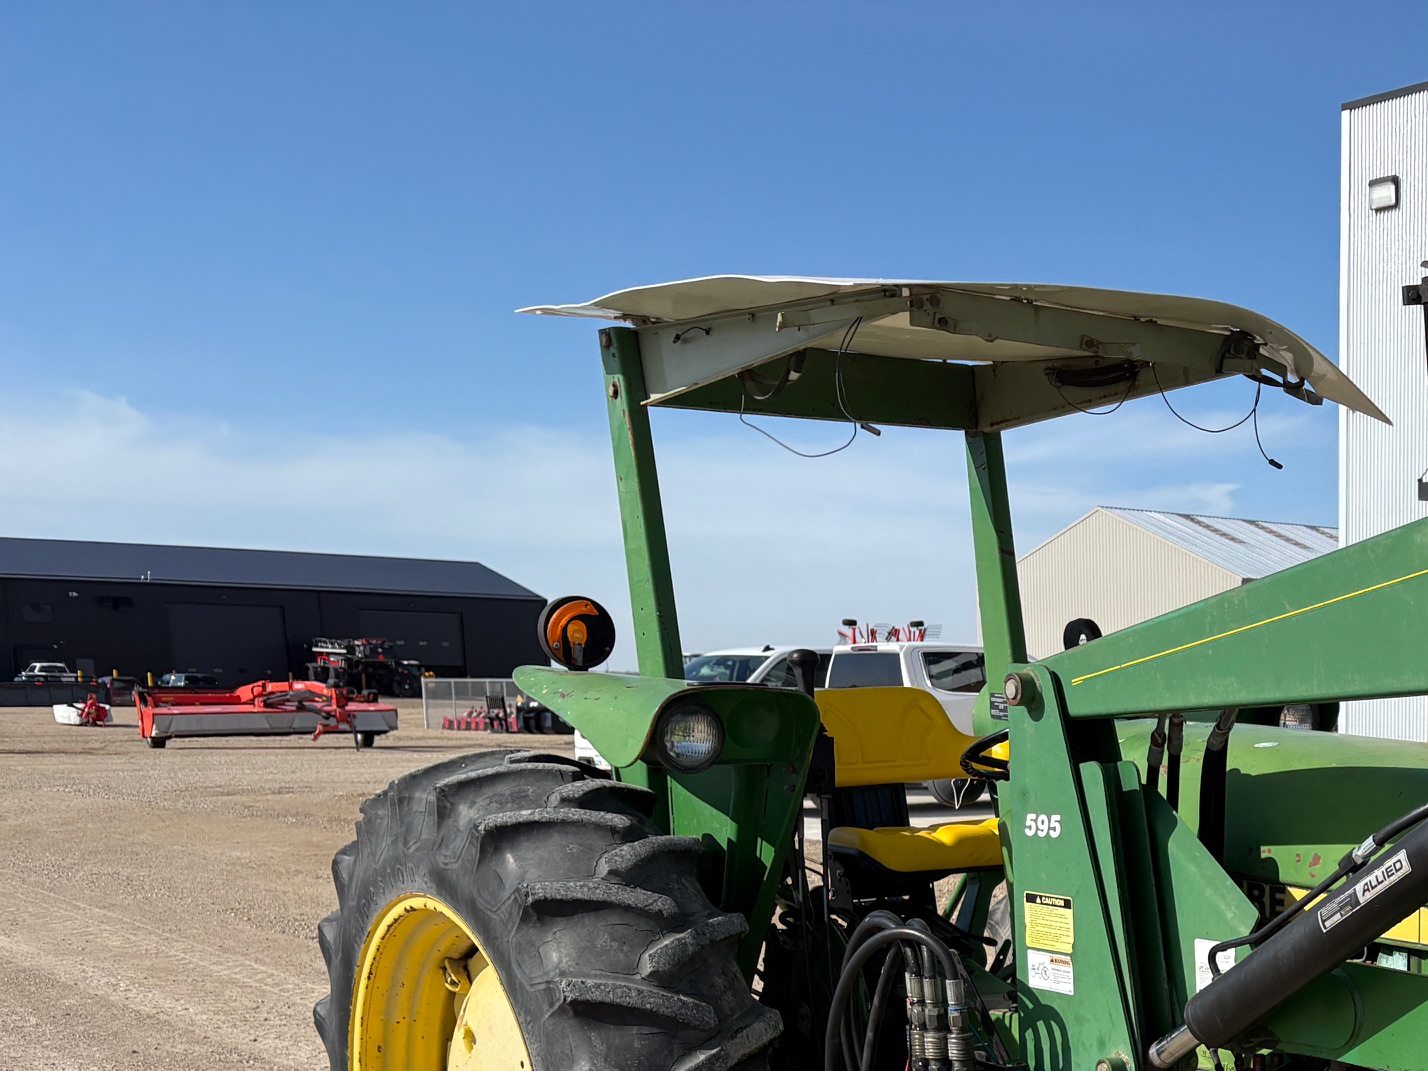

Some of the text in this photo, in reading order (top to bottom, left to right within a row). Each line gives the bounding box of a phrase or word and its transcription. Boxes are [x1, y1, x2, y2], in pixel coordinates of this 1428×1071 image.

[1024, 813, 1062, 839] 595
[1362, 858, 1404, 897] ALLIED
[1041, 896, 1065, 907] CAUTION
[1054, 958, 1071, 967] WARNING
